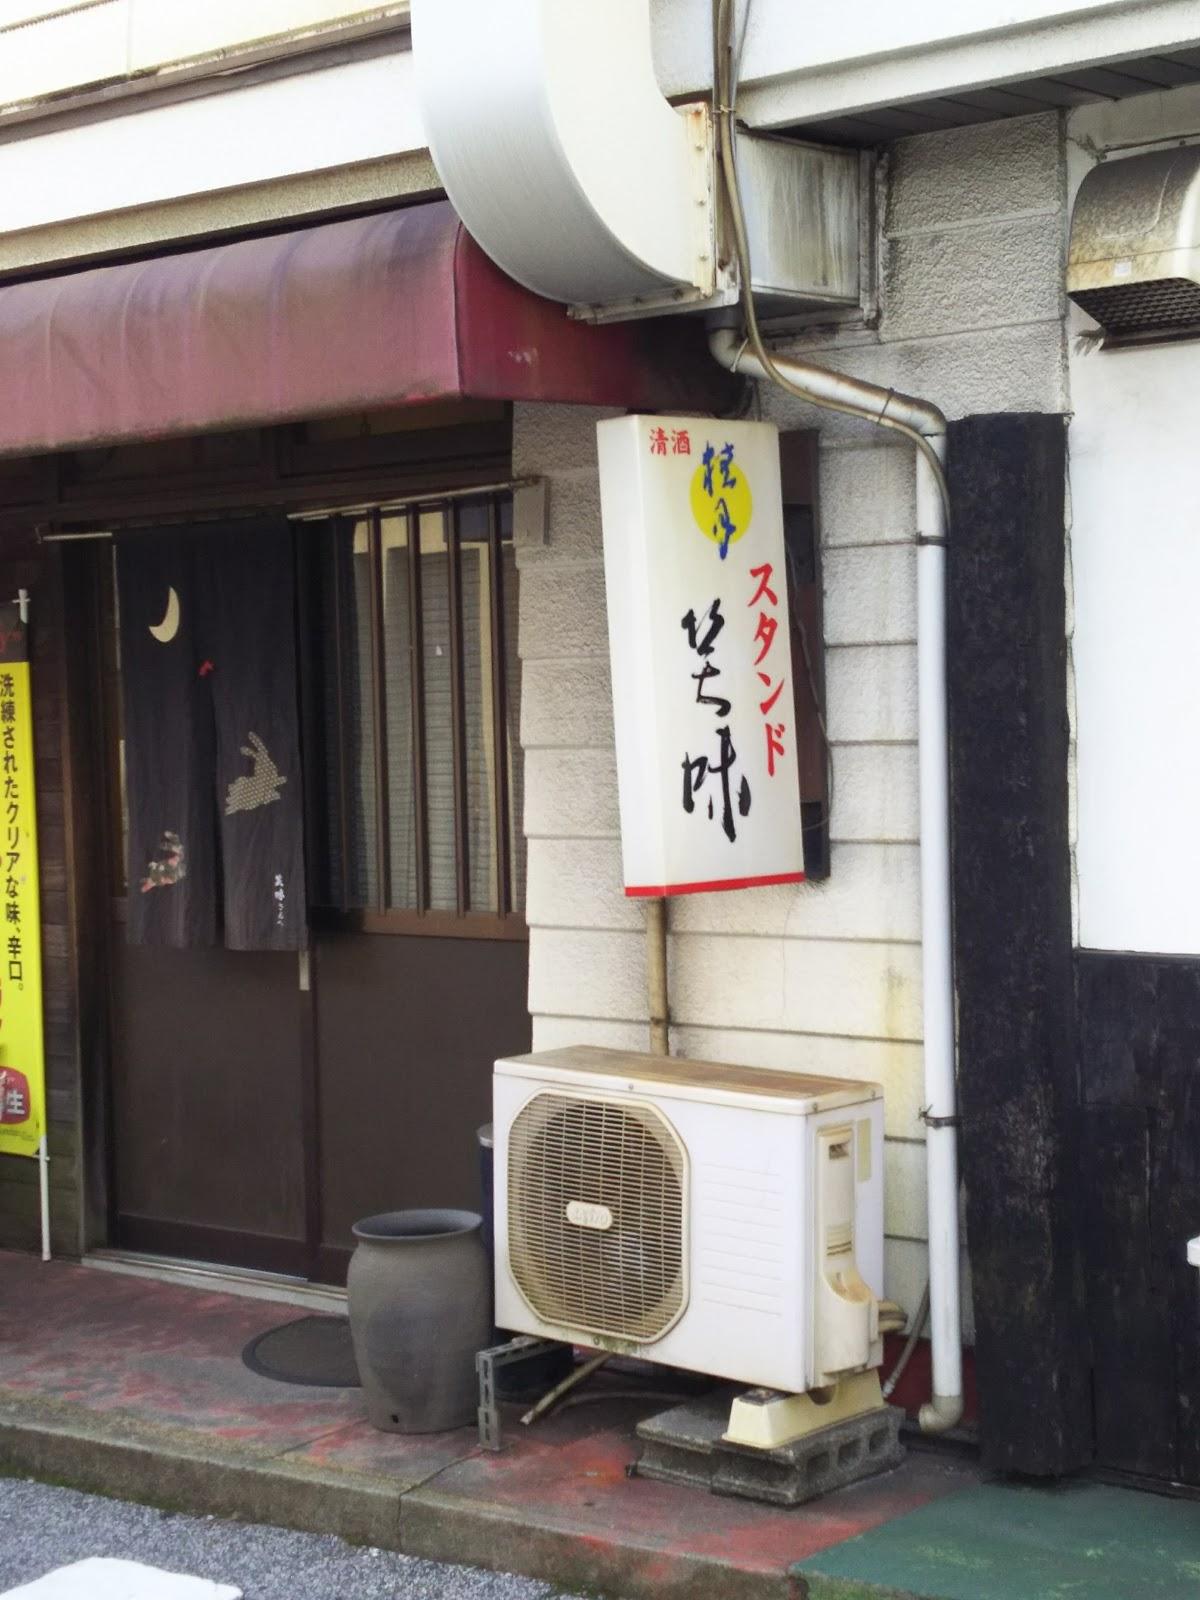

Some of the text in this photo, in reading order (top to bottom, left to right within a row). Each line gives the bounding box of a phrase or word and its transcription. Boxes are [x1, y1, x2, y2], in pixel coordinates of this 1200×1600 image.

[648, 426, 692, 457] 清酒
[746, 561, 786, 778] スタンド
